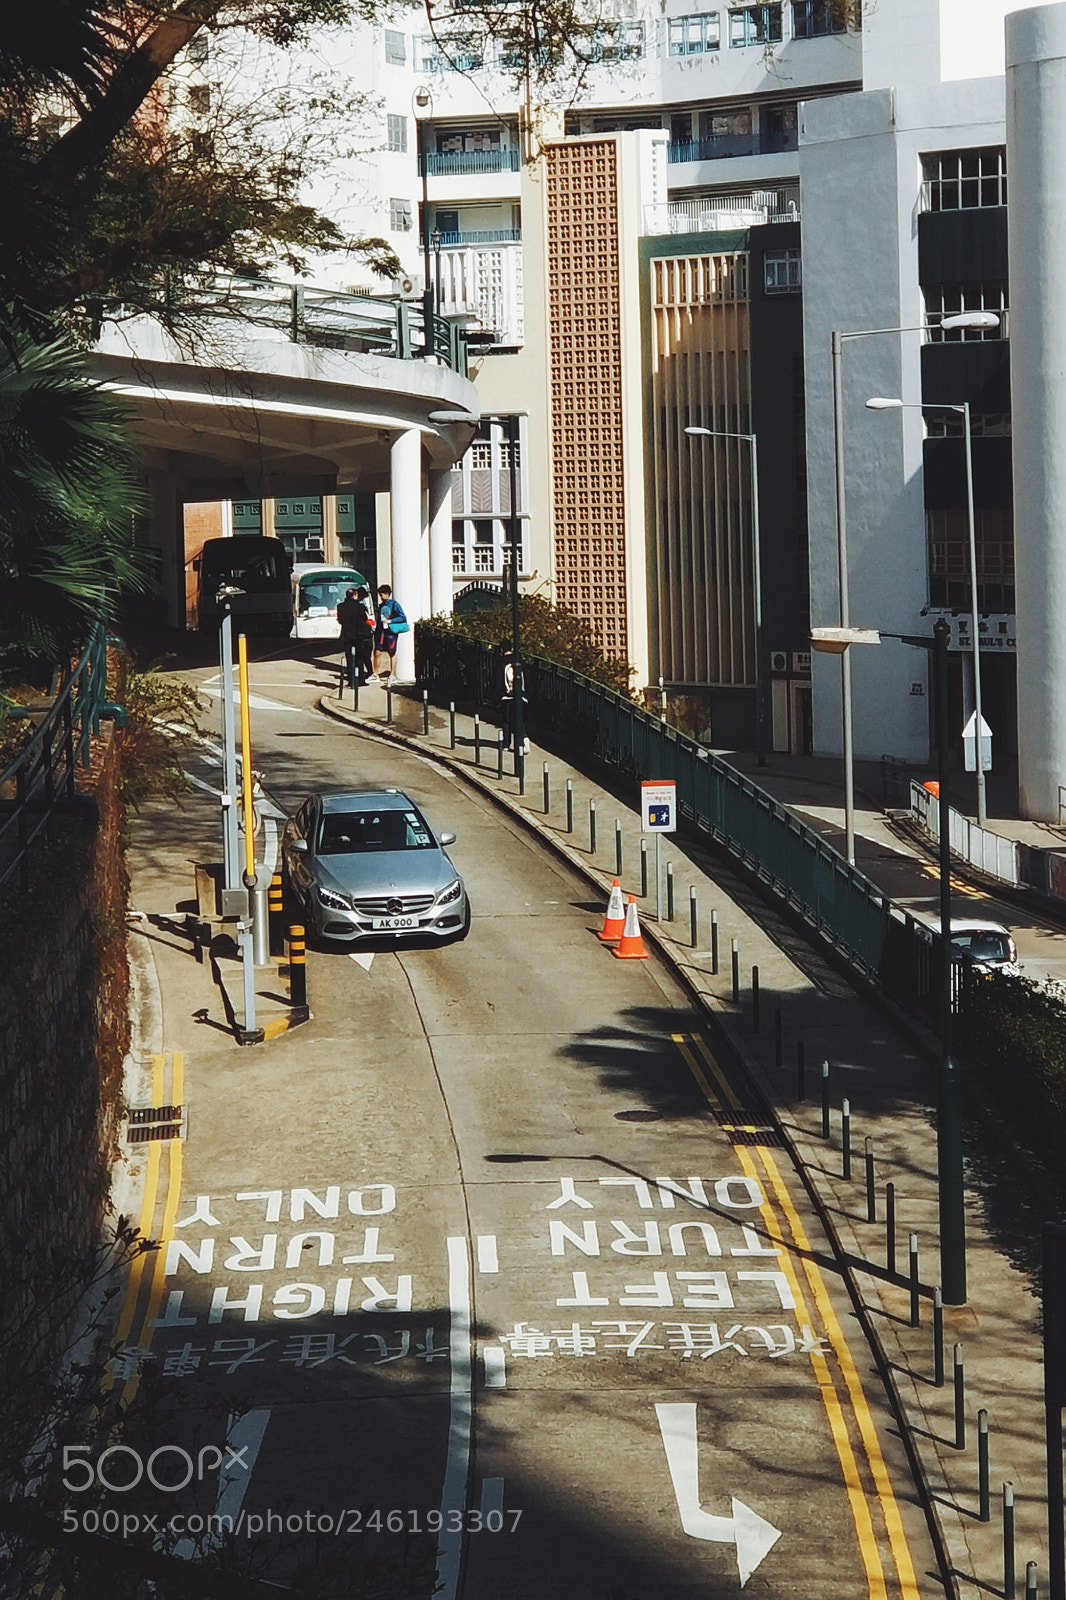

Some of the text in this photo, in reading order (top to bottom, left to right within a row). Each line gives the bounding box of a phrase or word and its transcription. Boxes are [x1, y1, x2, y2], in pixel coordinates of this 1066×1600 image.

[394, 918, 412, 926] 900
[174, 1183, 396, 1228] ONLY
[545, 1176, 765, 1209] ONLY
[164, 1227, 395, 1276] TURN
[550, 1220, 783, 1256] TURN
[148, 1275, 412, 1327] RIGHT
[556, 1271, 796, 1309] LEFT
